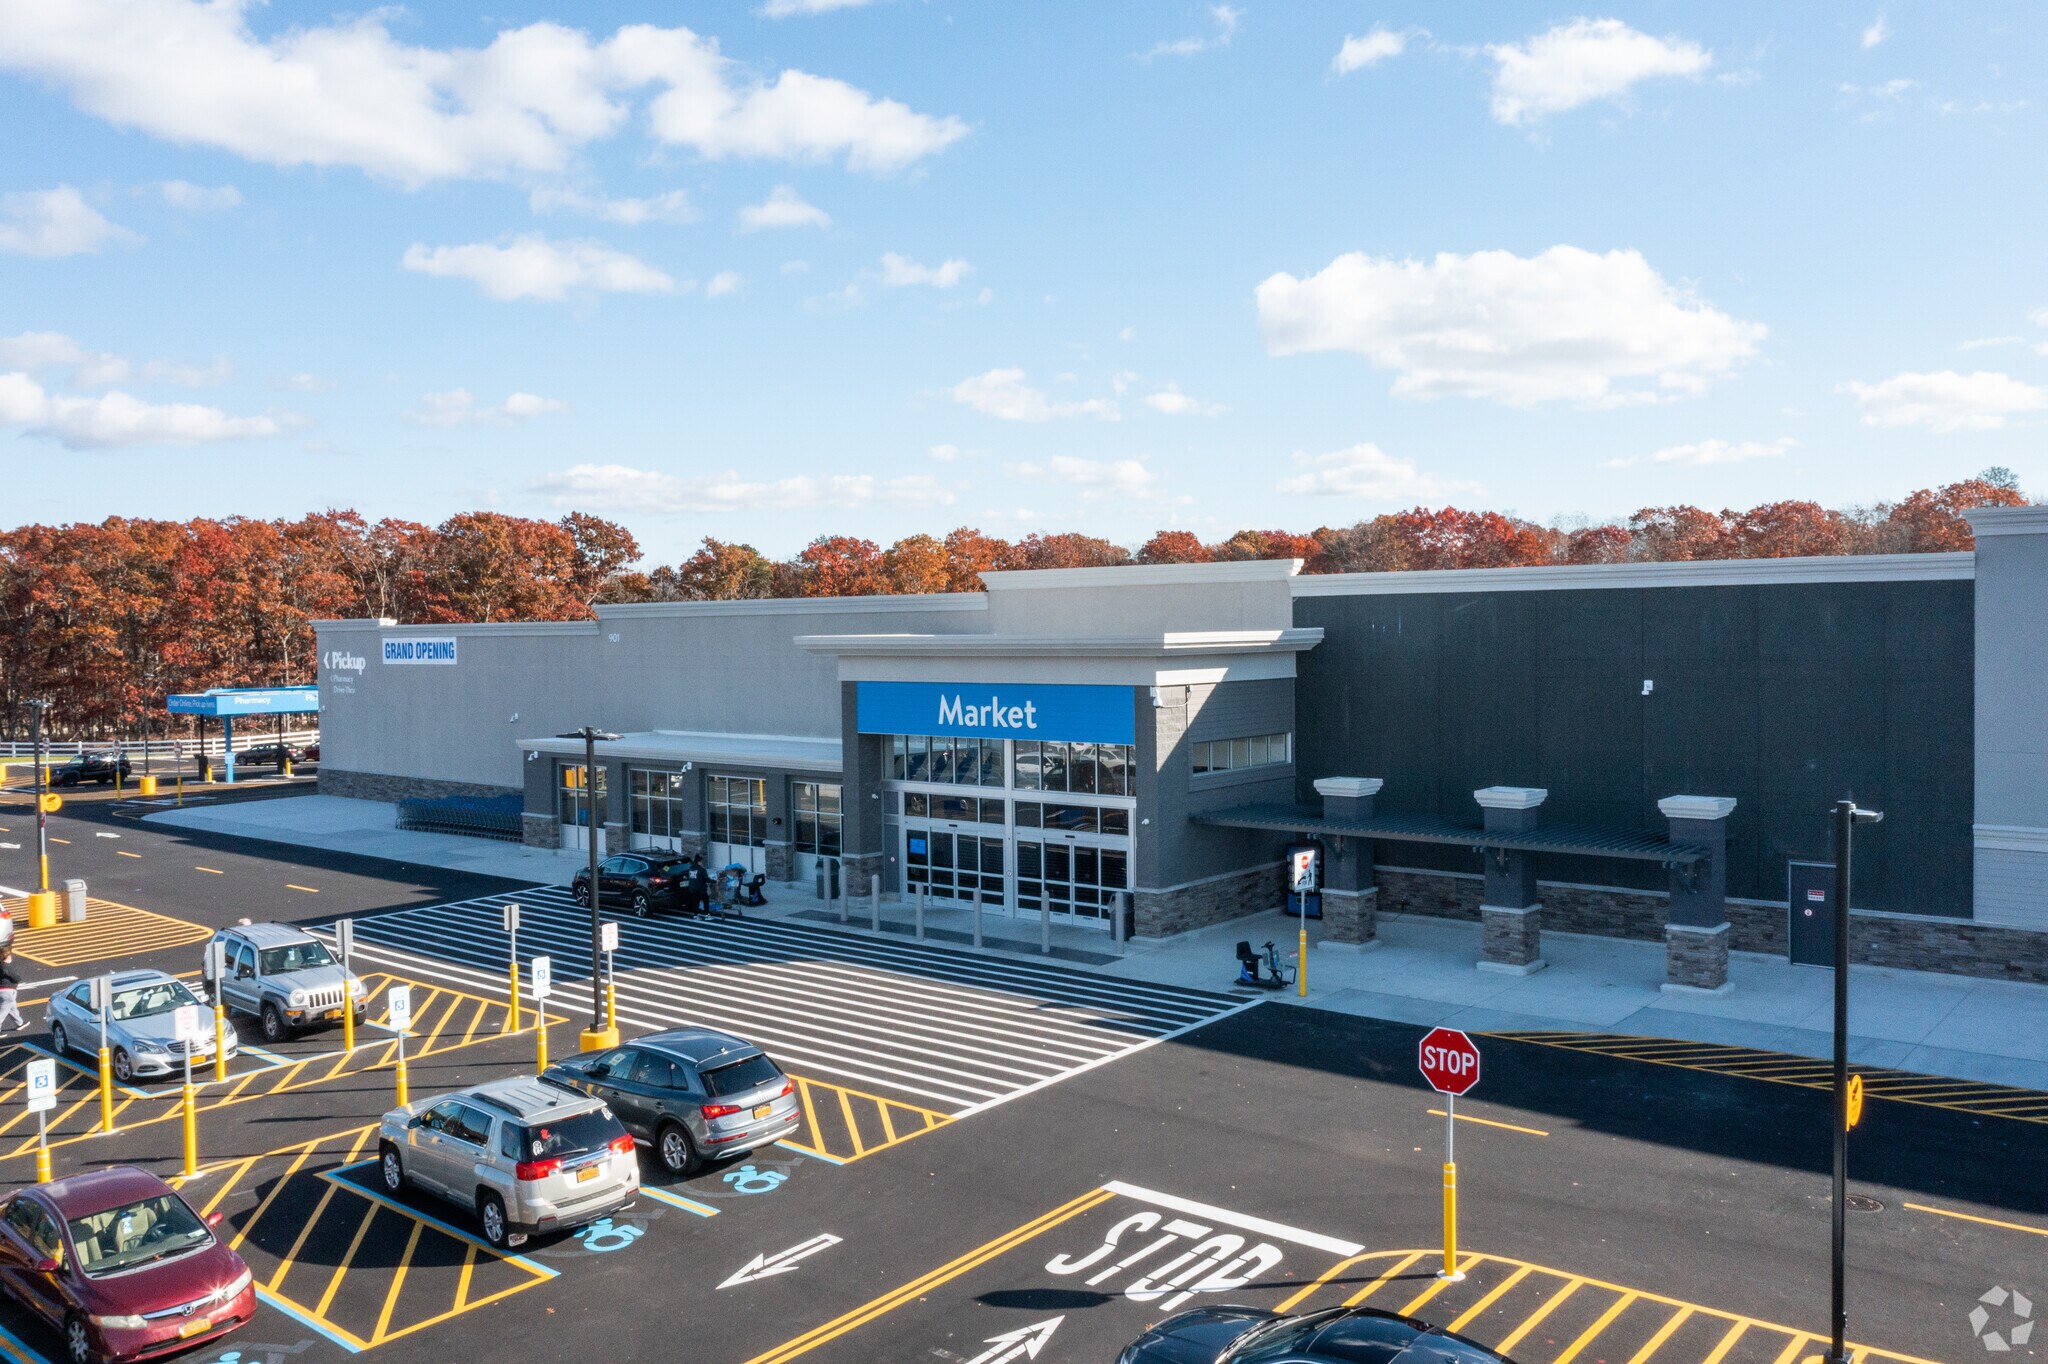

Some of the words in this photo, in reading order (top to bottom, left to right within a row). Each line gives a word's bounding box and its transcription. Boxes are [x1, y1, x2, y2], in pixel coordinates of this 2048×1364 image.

[384, 642, 414, 660] GRAND
[416, 641, 455, 660] OPENING
[608, 633, 620, 643] 901
[331, 651, 366, 676] Pickup
[234, 696, 272, 705] Pharmacy
[938, 693, 1038, 730] Market
[1423, 1045, 1475, 1076] STOP
[1044, 1211, 1284, 1312] STOP
